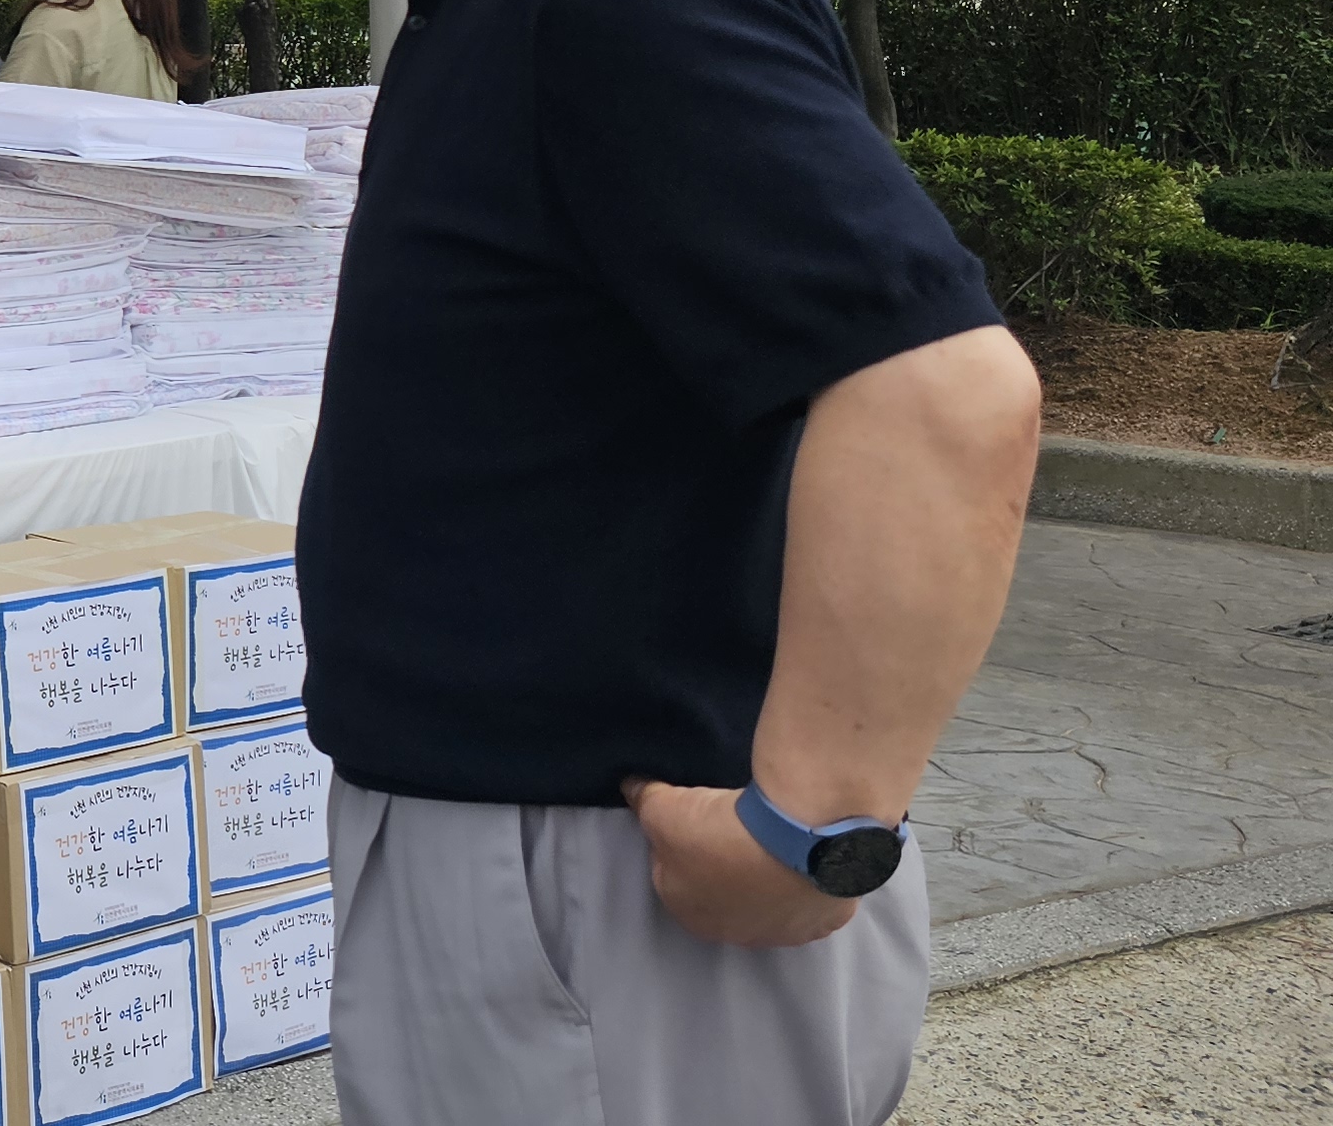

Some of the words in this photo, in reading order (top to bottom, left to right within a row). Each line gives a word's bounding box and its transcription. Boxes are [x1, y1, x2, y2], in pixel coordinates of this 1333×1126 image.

[272, 575, 296, 591] 건강지
[215, 610, 260, 637] 건강한
[268, 607, 297, 629] 여름
[28, 642, 79, 672] 건강한
[87, 634, 142, 661] 여름나기
[224, 645, 262, 671] 행복을
[40, 678, 82, 708] 행복을
[91, 671, 137, 696] 나누다
[215, 779, 262, 806] 건강한
[270, 770, 320, 796] 여름나기
[56, 826, 105, 857] 건강한
[113, 814, 168, 844] 여름나기
[224, 813, 264, 840] 행복을
[272, 805, 314, 828] 나누다
[67, 863, 109, 894] 행복을
[117, 853, 163, 879] 나누다
[241, 953, 288, 984] 건강한
[295, 942, 334, 967] 여름나
[61, 1006, 111, 1039] 건강한
[120, 990, 172, 1022] 여름나기
[253, 987, 290, 1017] 행복을
[72, 1043, 115, 1074] 행복을
[124, 1029, 167, 1057] 나누다
